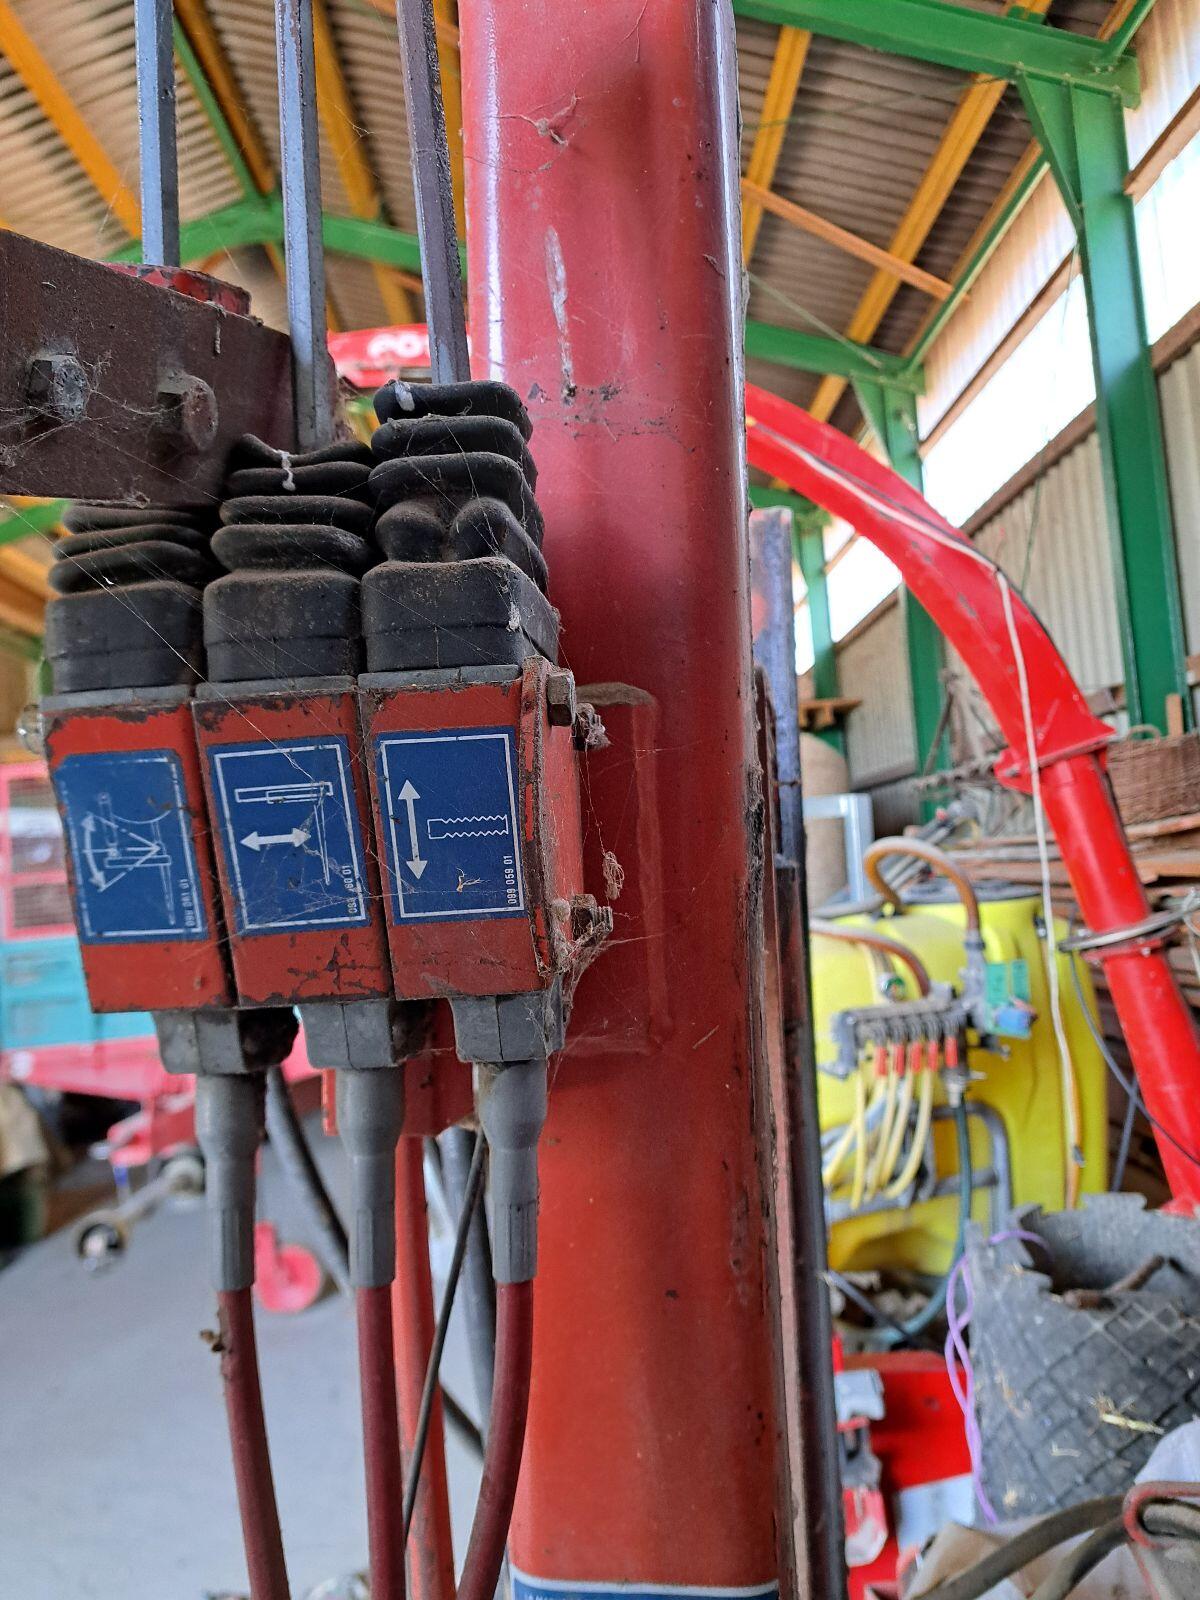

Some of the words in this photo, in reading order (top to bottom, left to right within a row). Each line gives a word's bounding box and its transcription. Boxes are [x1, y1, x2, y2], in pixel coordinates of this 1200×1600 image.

[503, 855, 513, 865] 01
[341, 865, 352, 875] 01
[504, 868, 515, 885] 059
[507, 888, 517, 904] 099
